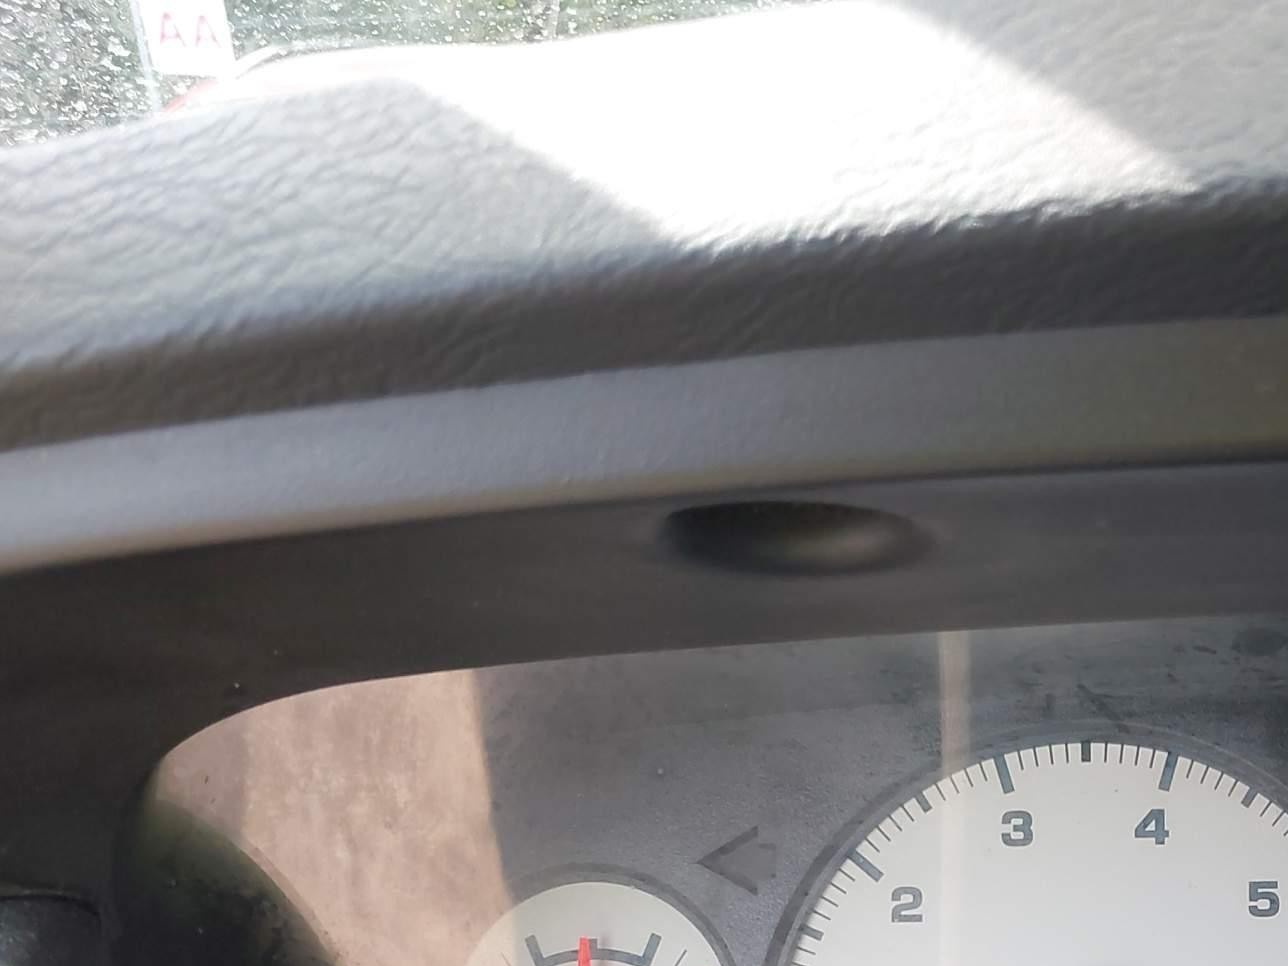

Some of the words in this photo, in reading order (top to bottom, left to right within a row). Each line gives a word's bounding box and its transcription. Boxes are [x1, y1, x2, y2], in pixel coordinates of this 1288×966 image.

[1001, 810, 1033, 847] 3
[1134, 808, 1170, 845] 4
[891, 886, 924, 923] 2
[1248, 881, 1280, 917] 5
